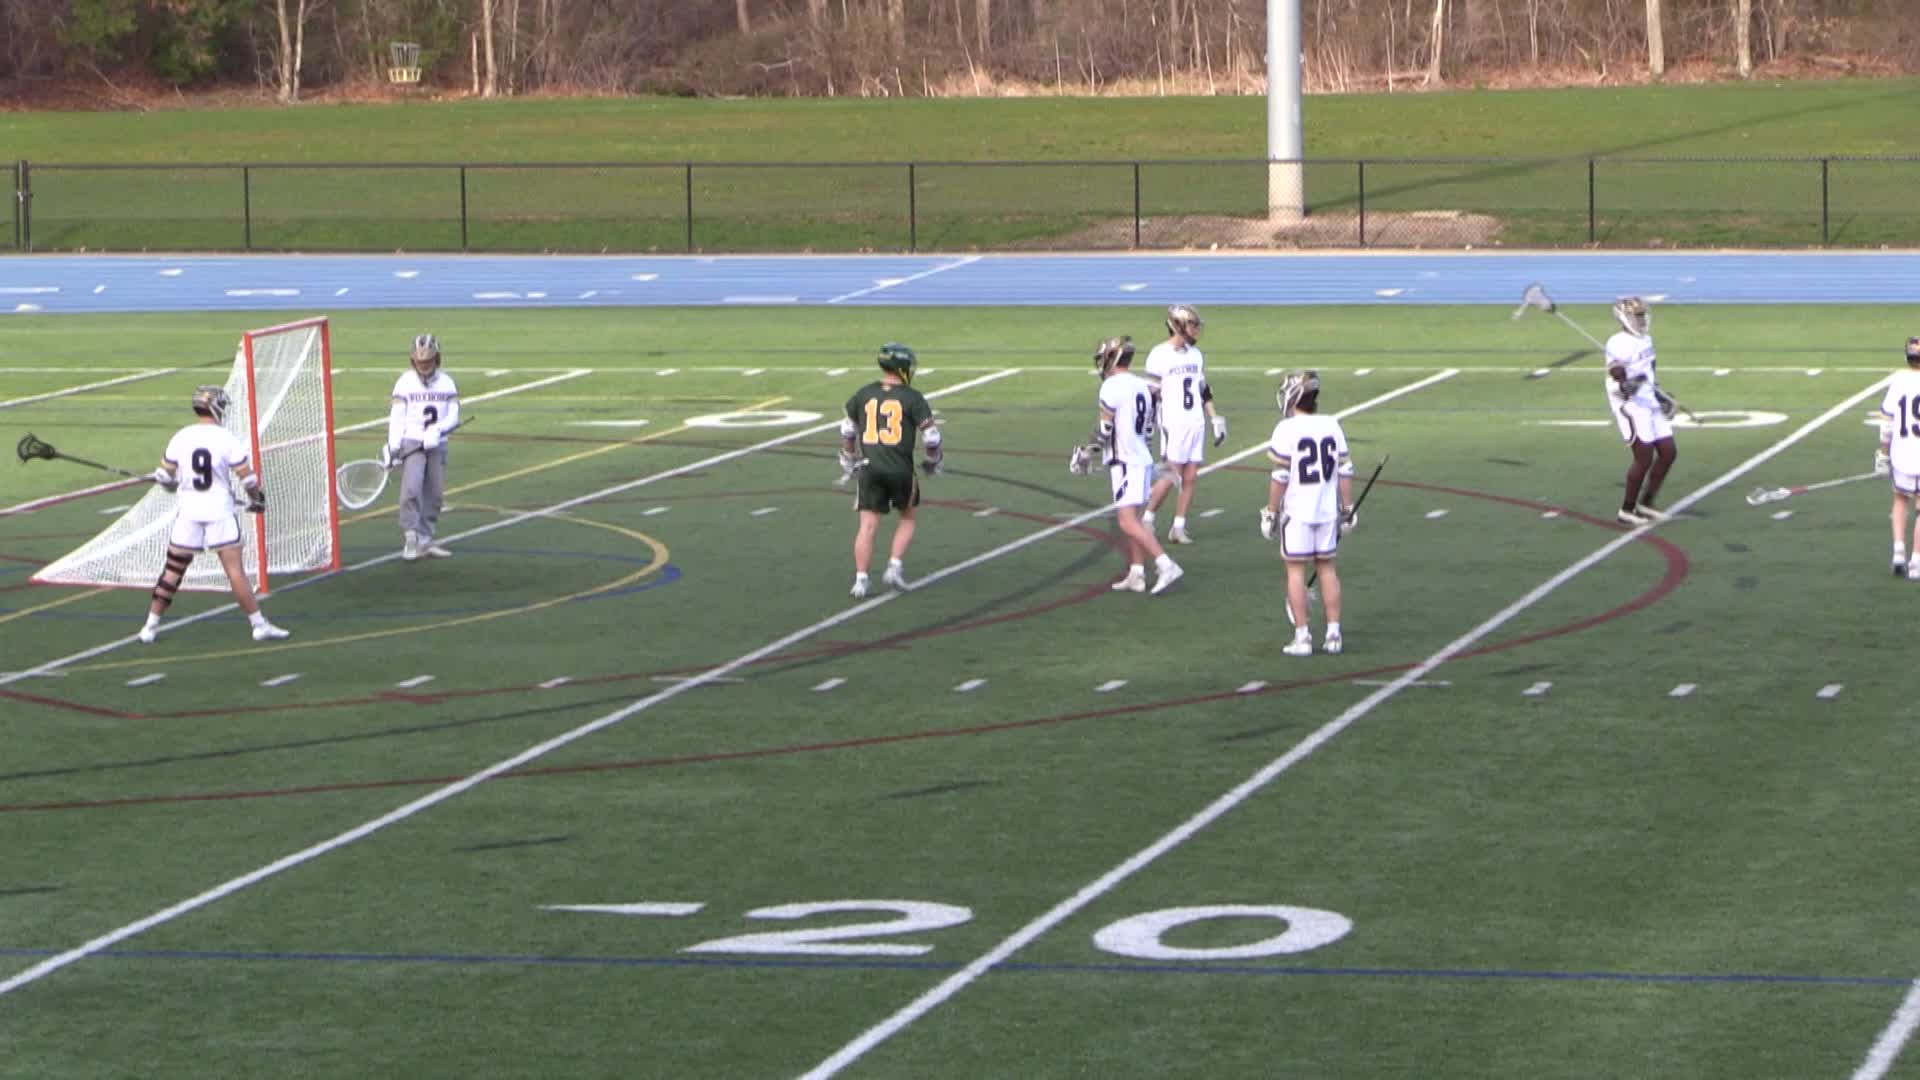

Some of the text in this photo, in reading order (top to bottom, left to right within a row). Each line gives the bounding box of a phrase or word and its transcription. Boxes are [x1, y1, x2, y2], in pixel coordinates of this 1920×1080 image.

[1135, 392, 1146, 435] 8
[1183, 377, 1194, 410] 6
[422, 405, 438, 431] 2
[862, 398, 903, 446] 13
[191, 447, 213, 491] 9
[1297, 435, 1337, 484] 26
